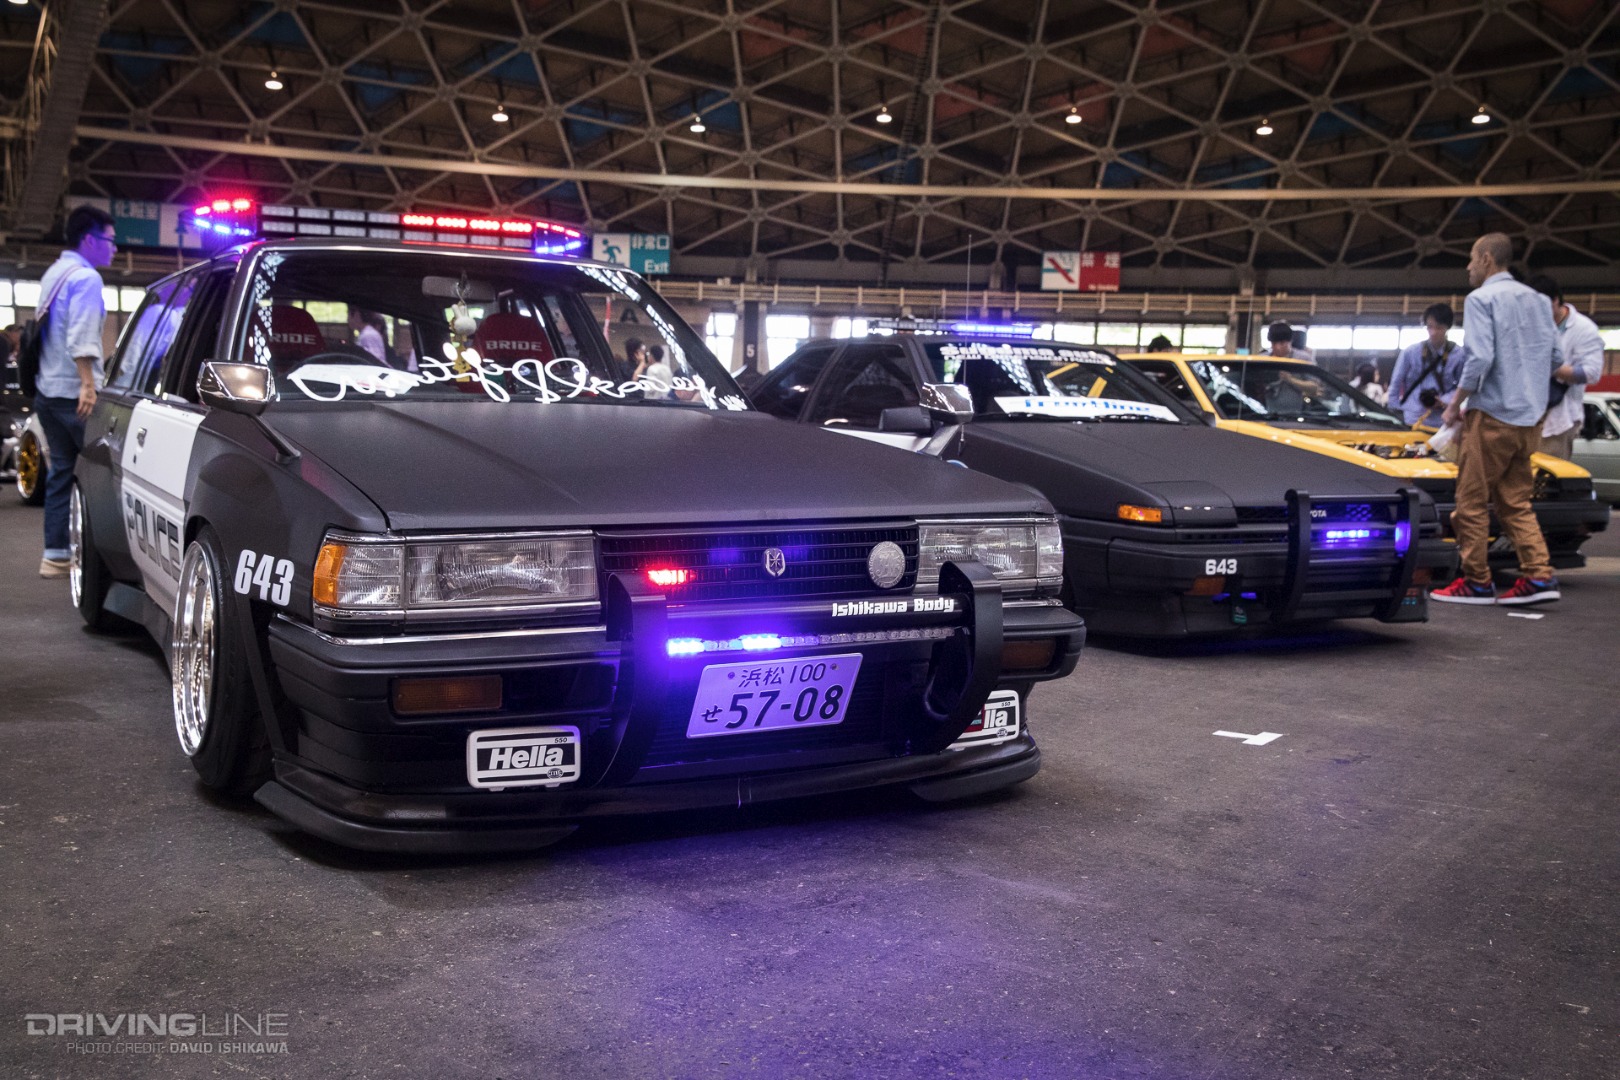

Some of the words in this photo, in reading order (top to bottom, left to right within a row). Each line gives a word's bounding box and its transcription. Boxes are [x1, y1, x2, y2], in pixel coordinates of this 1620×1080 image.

[631, 234, 670, 250] 非常口
[645, 259, 669, 274] Exit
[269, 332, 317, 345] RIDE
[485, 340, 543, 352] BRIDE
[124, 491, 182, 584] POLICE
[1205, 559, 1238, 575] 643
[234, 549, 295, 606] 643
[832, 601, 907, 617] Ishikawa
[914, 598, 955, 612] Body
[789, 663, 827, 684] 100
[701, 705, 723, 723] せ
[724, 684, 844, 729] 57-08
[983, 709, 1008, 729] lla
[489, 745, 564, 770] Hella
